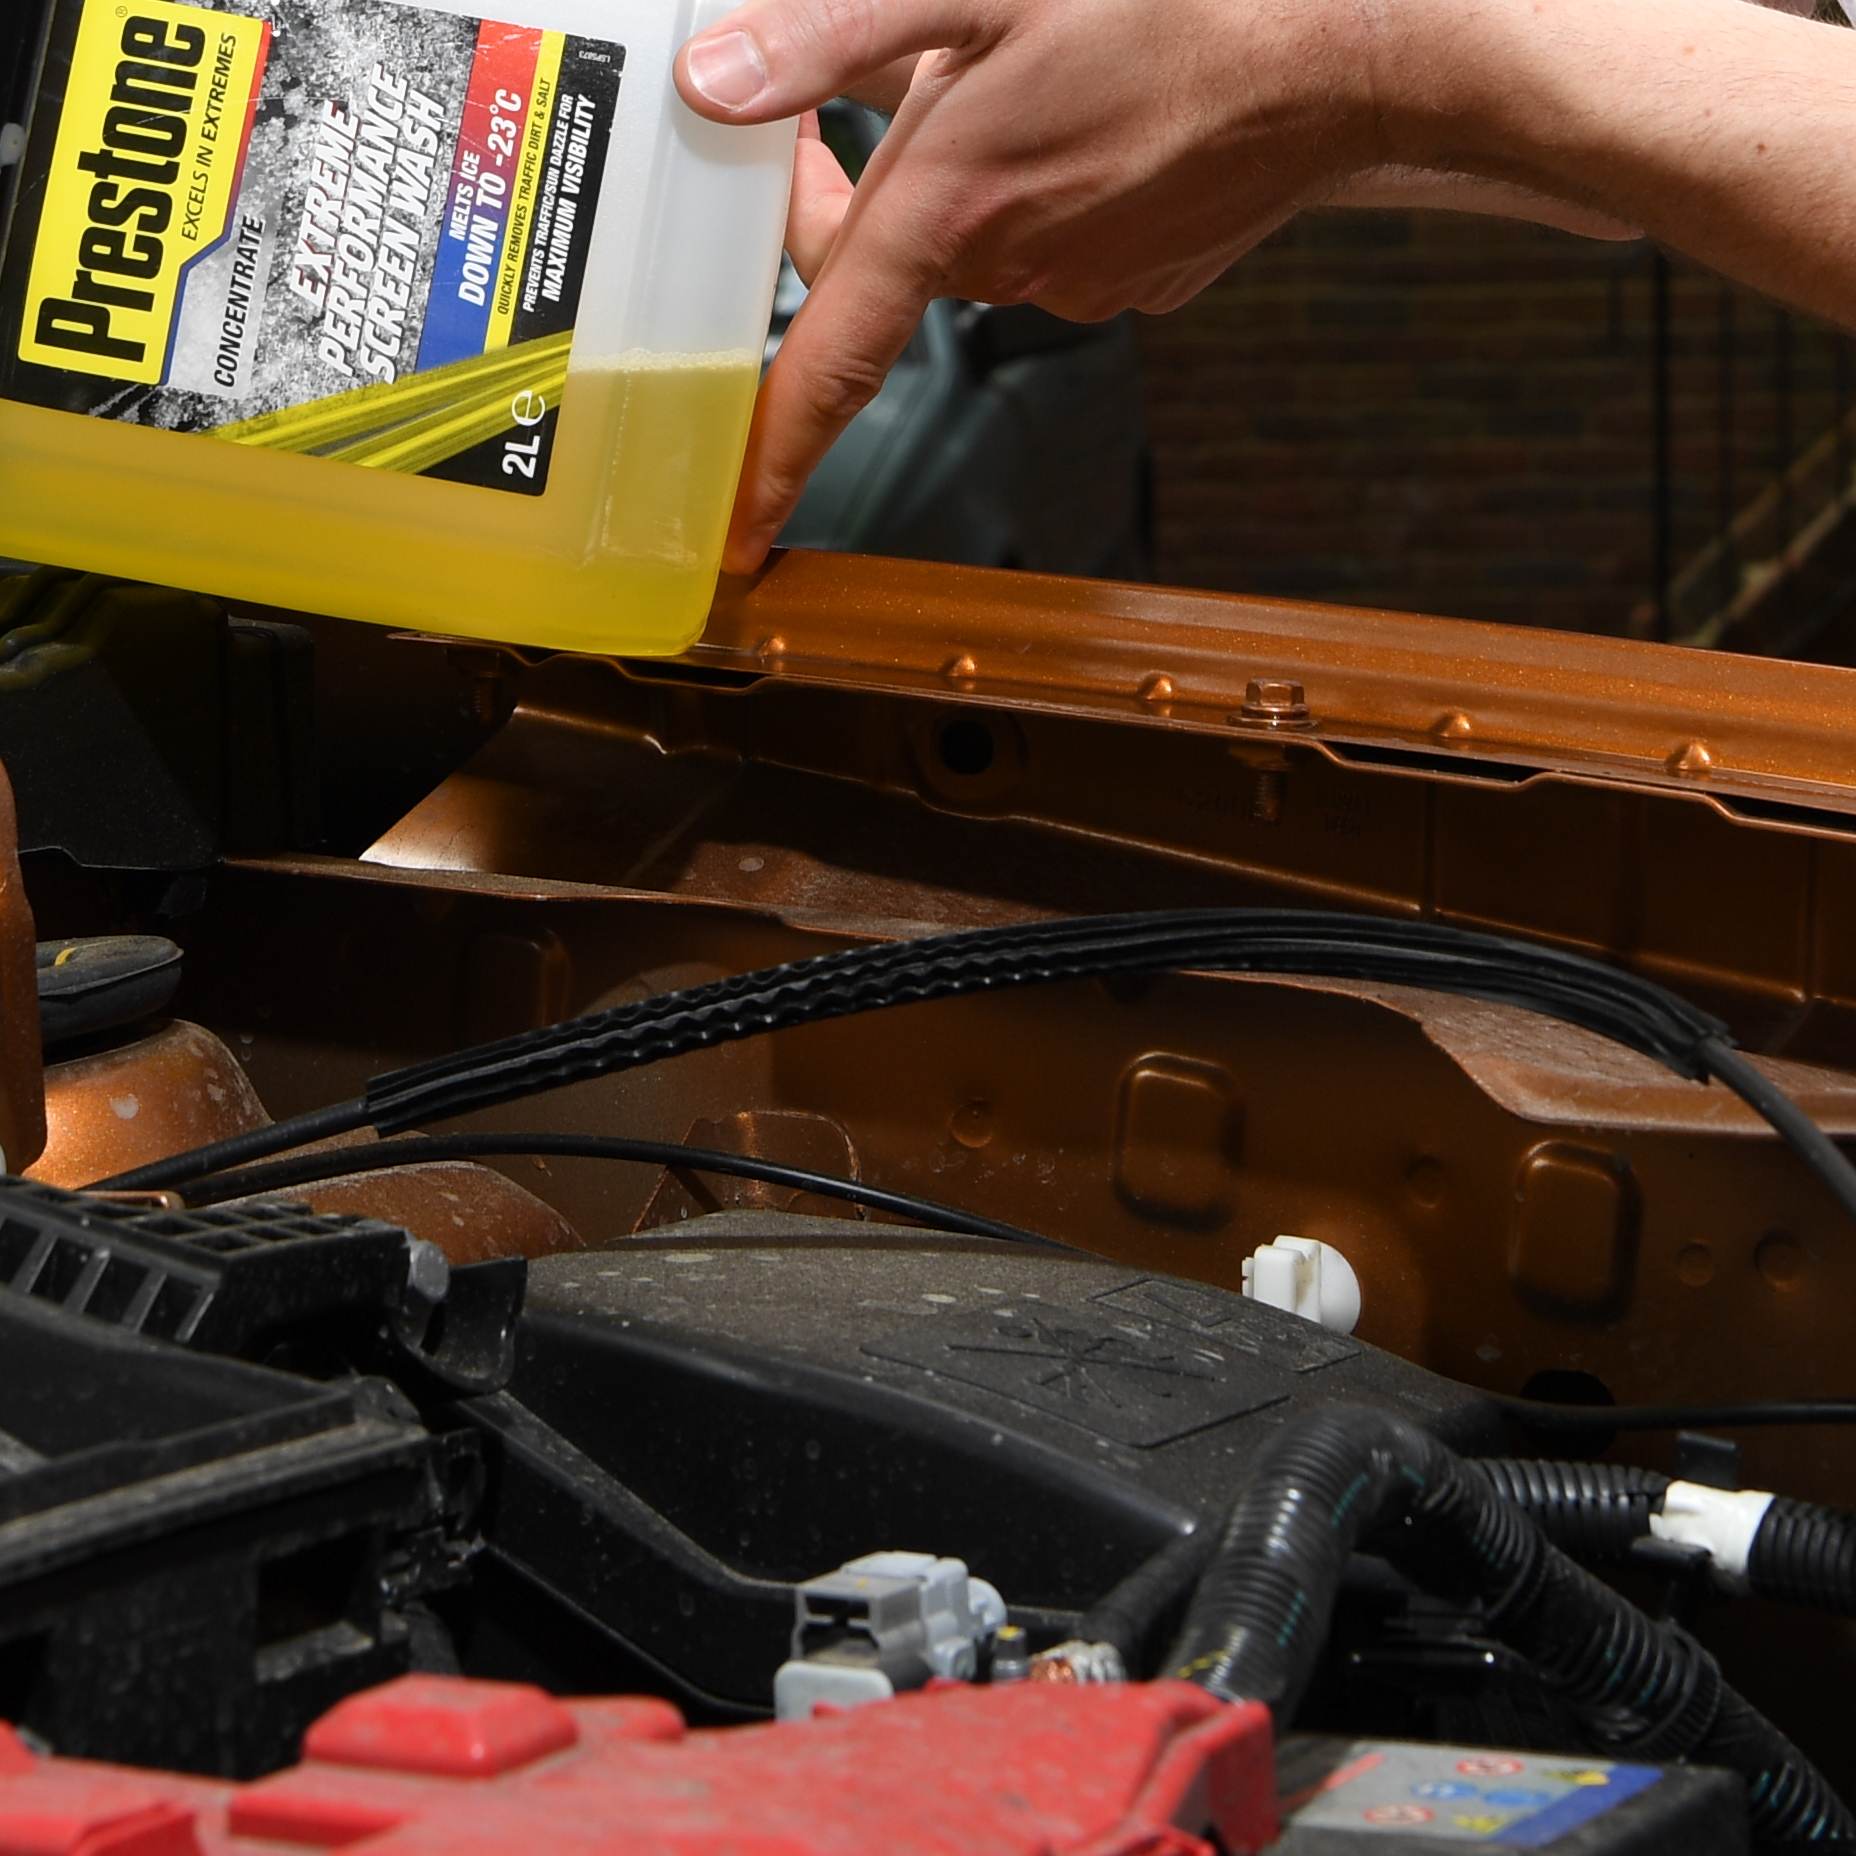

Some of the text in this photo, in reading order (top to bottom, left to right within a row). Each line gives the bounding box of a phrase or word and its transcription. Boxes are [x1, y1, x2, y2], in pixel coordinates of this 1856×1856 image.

[34, 15, 206, 363] Prestone
[181, 32, 237, 241] EXCELS IN EXTREMES
[290, 99, 360, 308] EXTREME
[318, 60, 409, 377] PERFORMANCE
[360, 88, 445, 384] SCREEN WASH
[449, 150, 480, 241] MELTS ICE
[458, 88, 522, 306] DOWN TO -23°C
[497, 77, 551, 315] QUICKLY REMOVES TRAFFIC DIRT & SALT
[522, 94, 574, 313] PREVENTS TRAFFIC/SUN DAZZLE FOR
[542, 94, 596, 302] MAXIMUM VISIBILITY
[214, 214, 266, 387] CONCENTRATE
[502, 435, 541, 478] 2L
